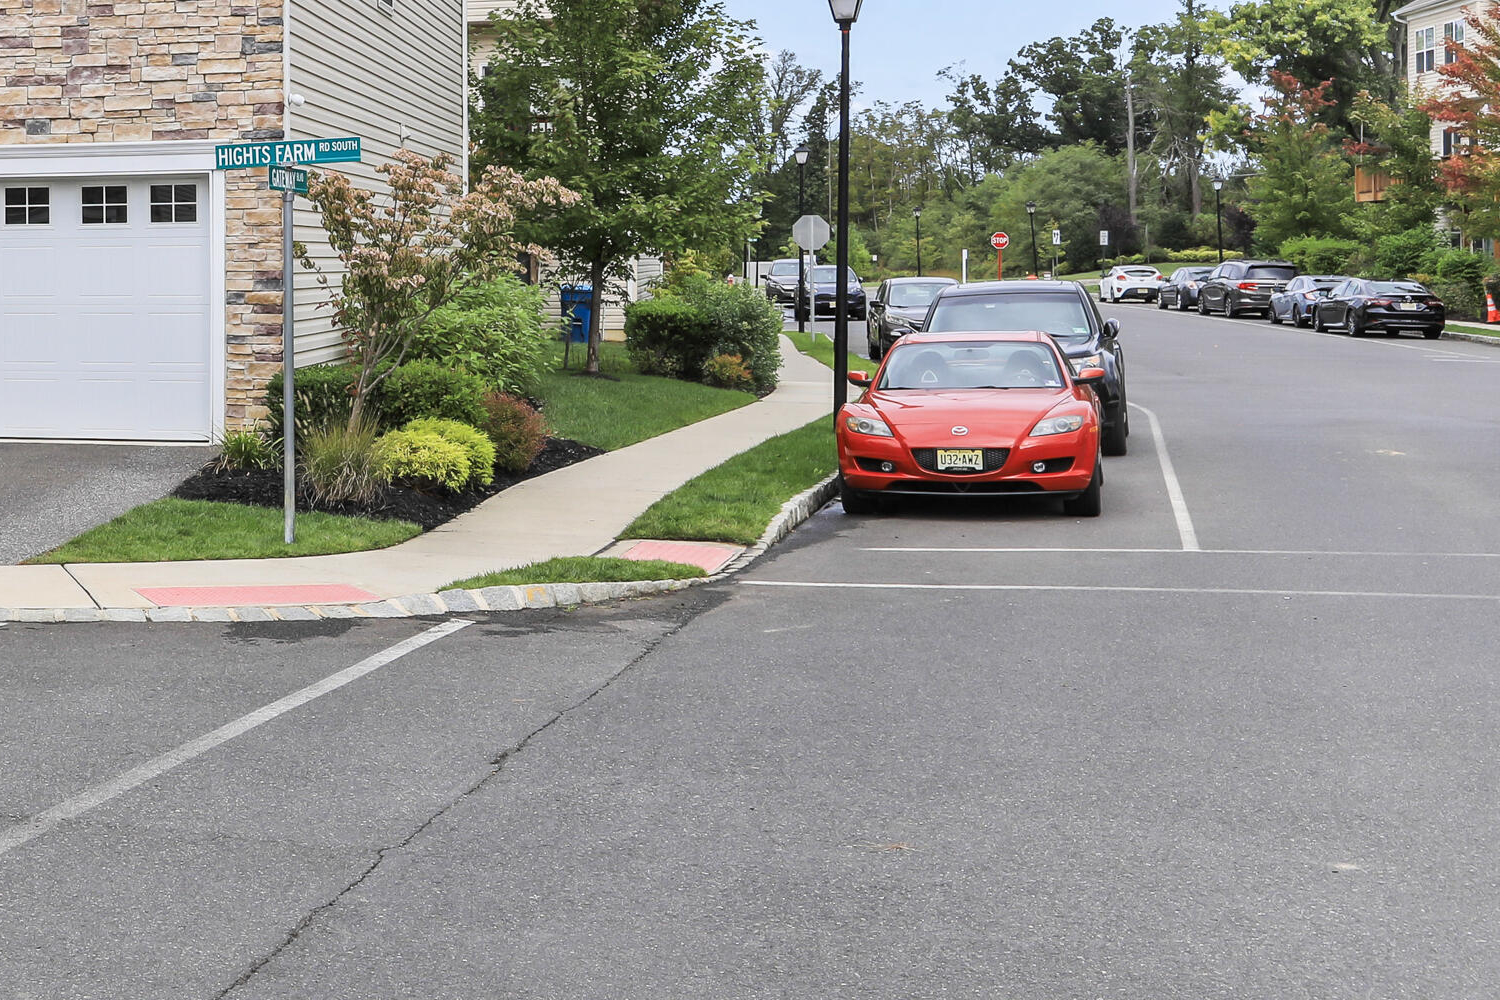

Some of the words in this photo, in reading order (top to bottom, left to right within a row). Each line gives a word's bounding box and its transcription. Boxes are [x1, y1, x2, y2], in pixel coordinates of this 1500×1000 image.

[218, 146, 271, 166] HIGHTS
[275, 143, 316, 162] FARM
[319, 142, 330, 152] RD
[331, 140, 358, 151] SOUTH
[272, 168, 296, 189] GATEWAY
